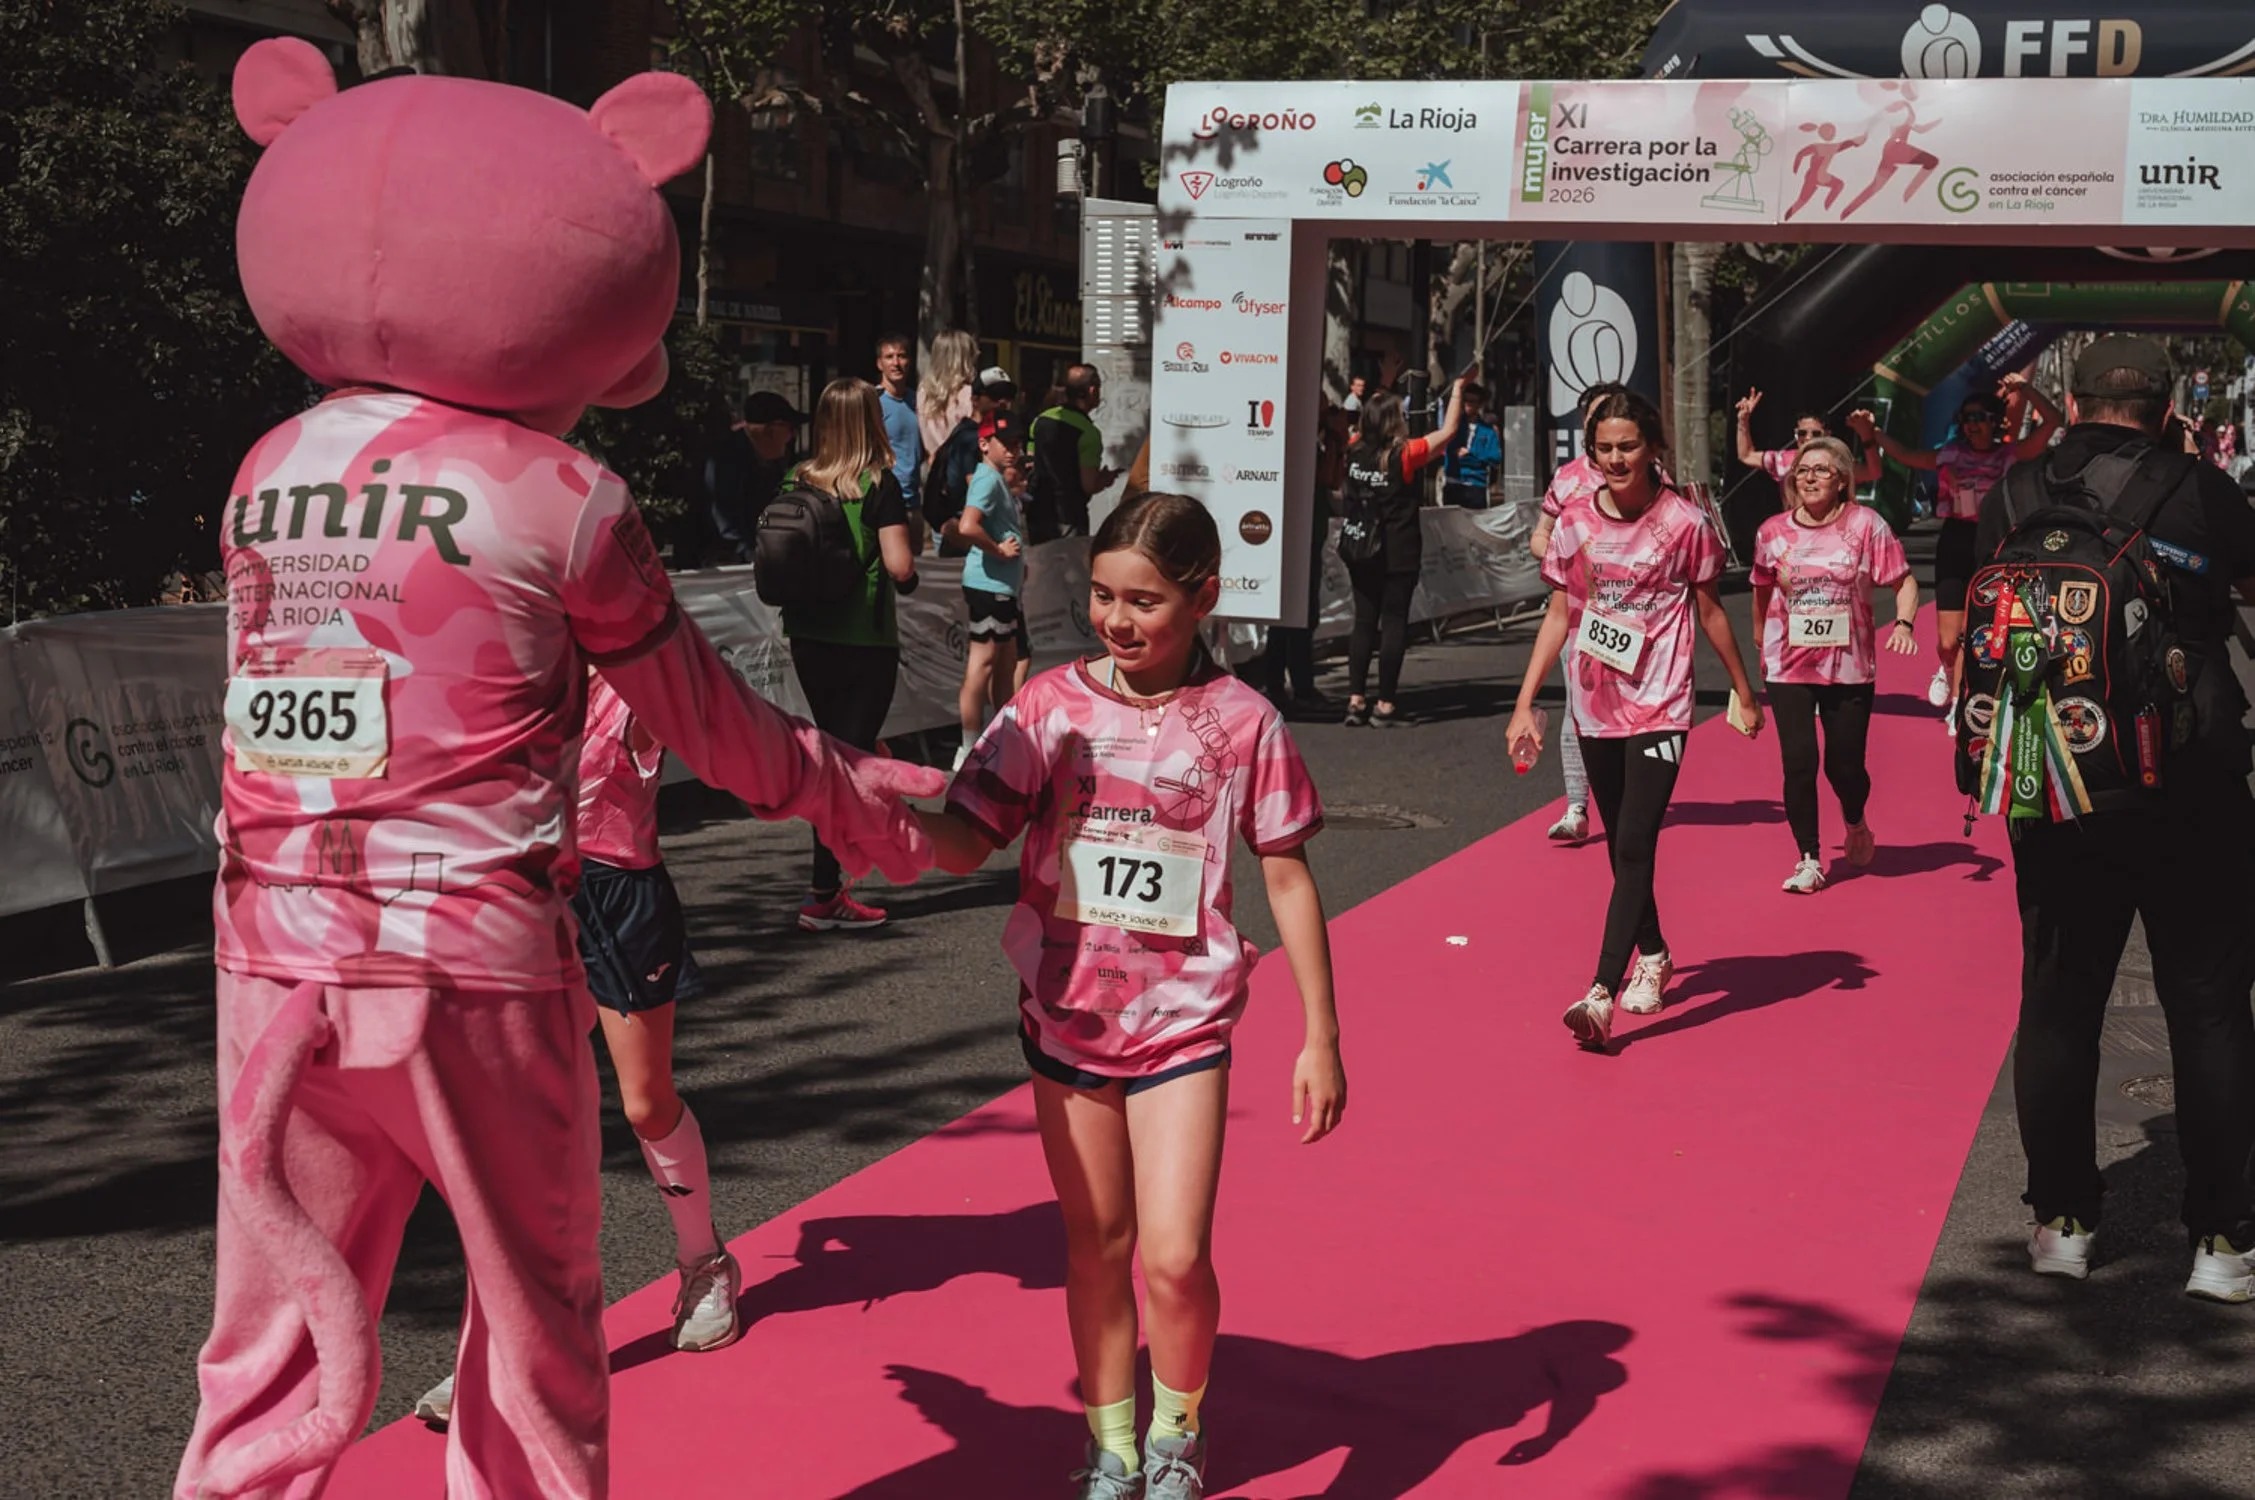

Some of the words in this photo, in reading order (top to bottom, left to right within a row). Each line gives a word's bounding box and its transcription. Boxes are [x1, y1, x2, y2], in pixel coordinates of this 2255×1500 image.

[2004, 19, 2142, 77] FFD
[1201, 106, 1317, 131] LOGROÑO
[1389, 108, 1414, 129] La
[1419, 107, 1477, 133] Rioja
[1556, 103, 1588, 129] XI
[2173, 110, 2254, 125] HUMILDAD
[1524, 112, 1549, 193] mujer
[1553, 137, 1641, 156] Carrera
[1648, 141, 1691, 161] por
[1694, 137, 1718, 156] la
[1215, 175, 1263, 189] Logroño
[1551, 161, 1711, 187] investigación
[1989, 171, 2055, 184] asociación
[2058, 171, 2115, 186] española
[1549, 188, 1595, 204] 2026
[1989, 185, 2025, 197] contra
[2028, 185, 2042, 197] el
[2045, 184, 2088, 197] cáncer
[1988, 201, 2004, 211] en
[2006, 199, 2022, 211] La
[2024, 199, 2055, 212] Rioja
[1163, 295, 1222, 311] Alcampo
[1233, 354, 1279, 364] VIVAGYM
[1248, 401, 1259, 427] I
[1236, 470, 1279, 482] ARNAUT
[232, 580, 407, 604] INTERNACIONAL
[251, 607, 277, 629] LA
[283, 605, 344, 627] RIOJA
[1803, 619, 1834, 636] 267
[1588, 620, 1632, 654] 8539
[248, 690, 358, 741] 9365
[1077, 776, 1097, 795] XI
[1079, 801, 1153, 824] Carrera
[1097, 855, 1164, 903] 173
